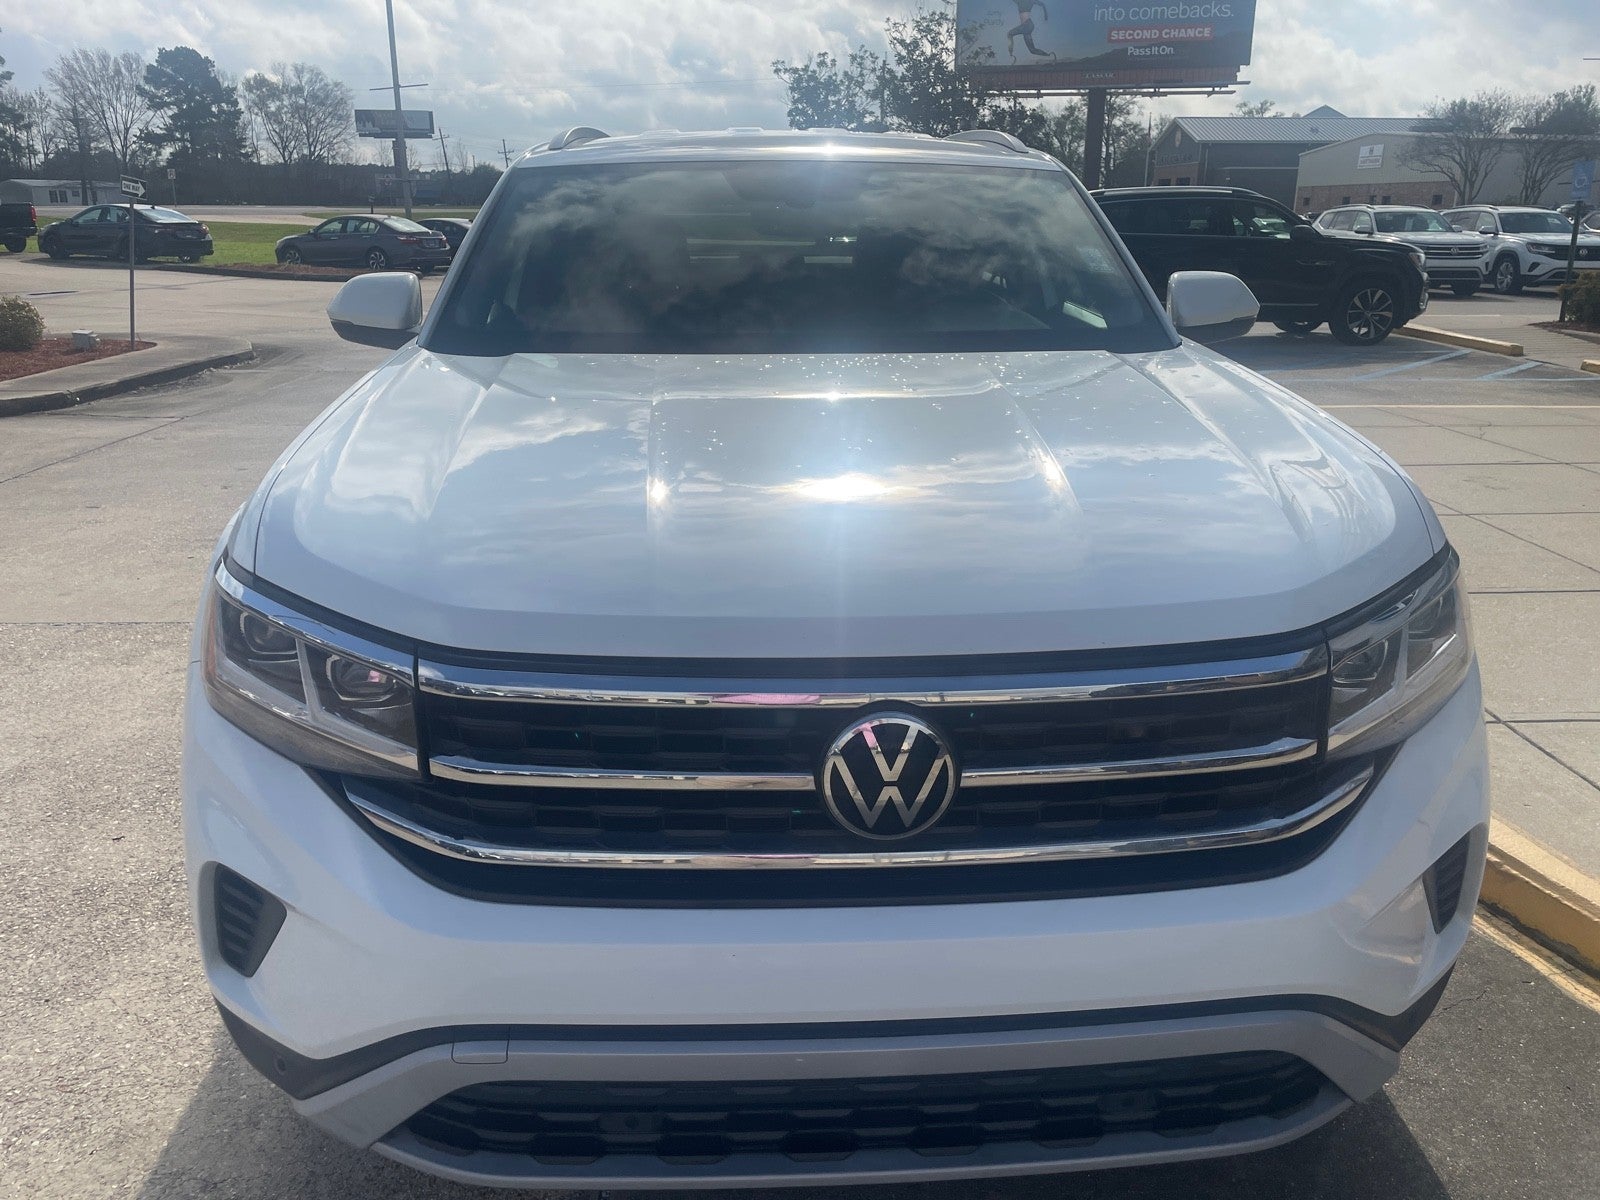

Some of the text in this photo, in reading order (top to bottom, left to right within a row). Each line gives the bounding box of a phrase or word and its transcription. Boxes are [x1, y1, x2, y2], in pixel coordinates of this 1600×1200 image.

[1094, 2, 1234, 21] into comebacks.
[1111, 27, 1211, 40] SECOND CHANCE
